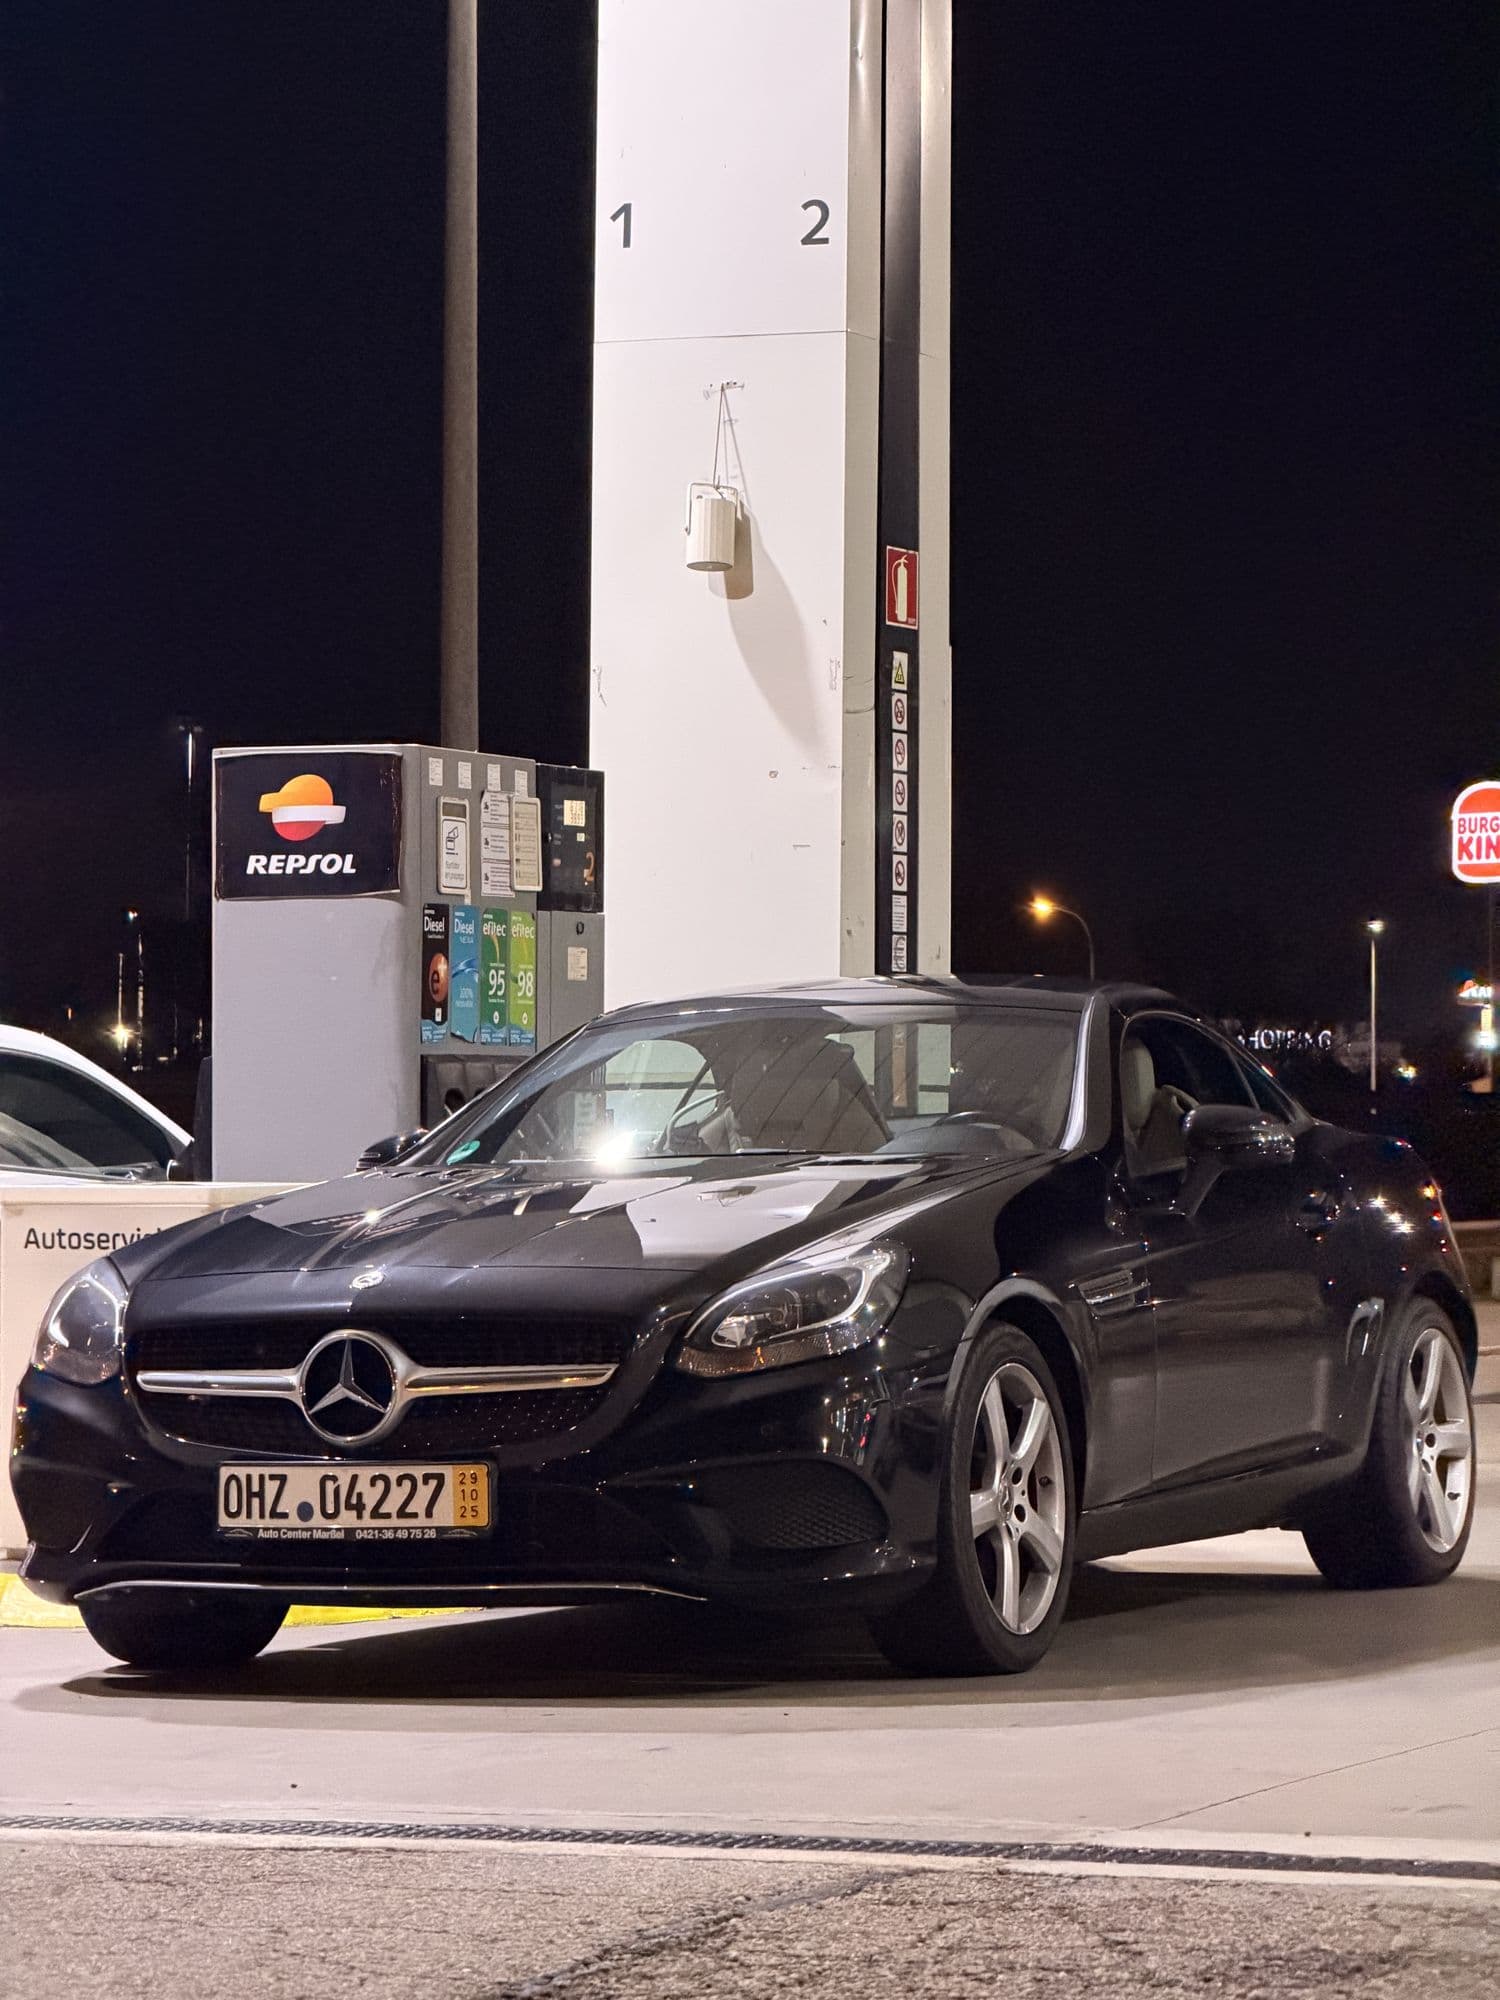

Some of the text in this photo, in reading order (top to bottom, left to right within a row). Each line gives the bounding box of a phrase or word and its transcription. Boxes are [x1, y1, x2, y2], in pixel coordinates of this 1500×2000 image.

[610, 202, 632, 248] 1
[800, 199, 830, 245] 2
[246, 853, 356, 875] REPSOL
[424, 916, 445, 932] Diesel
[454, 918, 475, 935] Diesel
[483, 921, 507, 937] efitec
[511, 923, 535, 939] efitec
[488, 969, 506, 996] 95
[517, 971, 534, 997] 98
[24, 1227, 161, 1250] Autoservi
[458, 1471, 479, 1486] 29
[223, 1472, 446, 1520] OHZ 04227
[459, 1488, 479, 1502] 10
[459, 1504, 479, 1518] 25
[257, 1528, 279, 1539] Auto
[280, 1528, 311, 1539] Center
